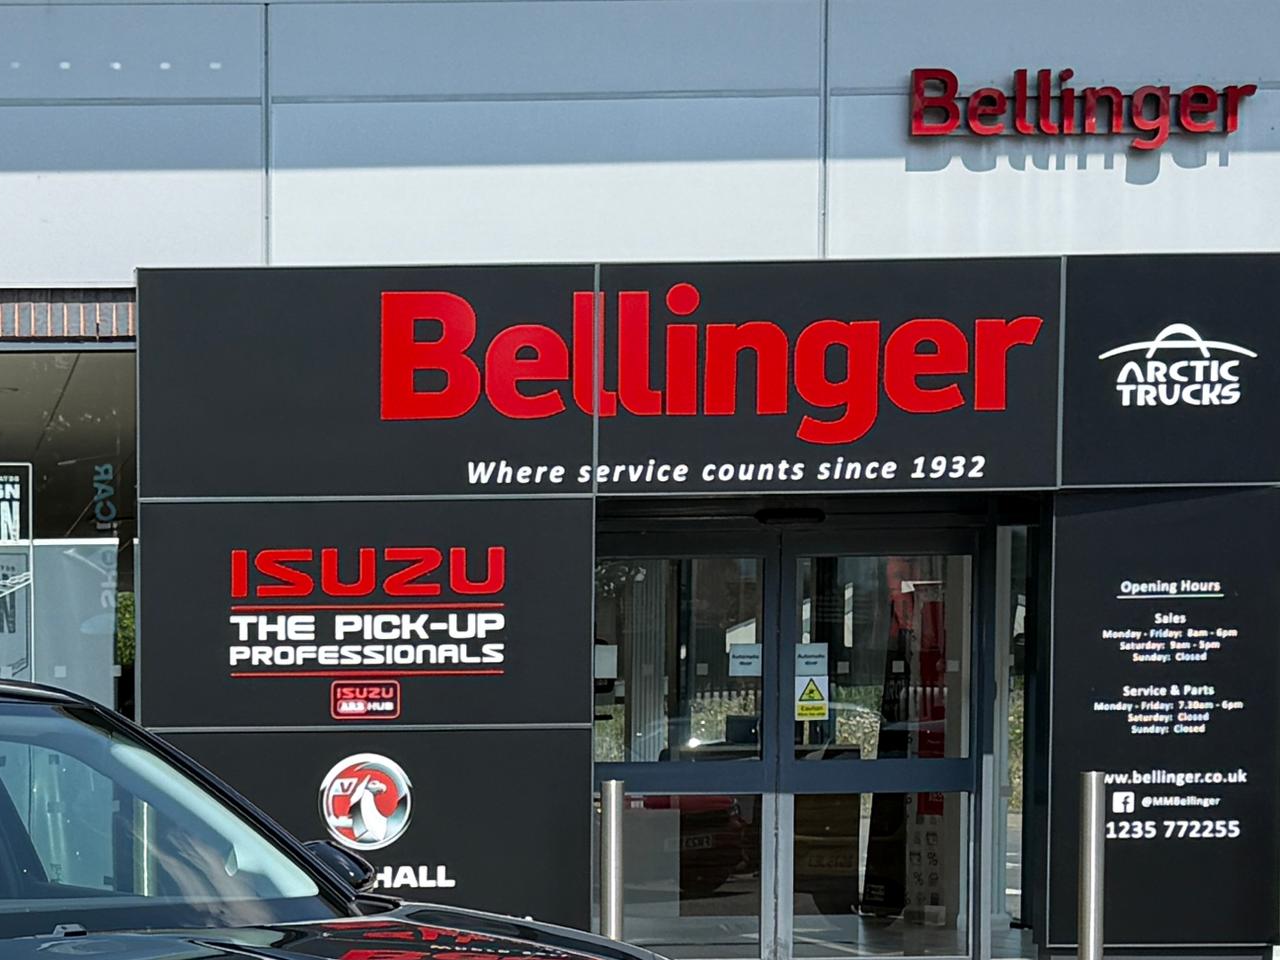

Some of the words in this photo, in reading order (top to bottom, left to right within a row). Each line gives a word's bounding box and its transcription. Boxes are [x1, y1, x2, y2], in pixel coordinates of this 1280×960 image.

[911, 68, 1257, 149] Bellinger
[380, 283, 1043, 445] Bellinger
[1117, 360, 1240, 383] ARCTIC
[1116, 383, 1241, 406] TRUCKS
[468, 460, 565, 484] Where
[577, 459, 689, 483] service
[702, 459, 805, 482] counts
[817, 457, 898, 480] since
[911, 455, 986, 479] 1932
[231, 547, 505, 597] ISUZU
[1120, 580, 1177, 595] Opening
[1180, 580, 1221, 592] Hours
[1154, 612, 1187, 624] Sales
[229, 615, 315, 641] THE
[335, 613, 505, 640] PICK-UP
[1102, 630, 1142, 640] Monday
[229, 643, 505, 666] PROFESSIONALS
[1175, 652, 1208, 661] Closed
[337, 687, 394, 699] ISUZU
[1122, 685, 1167, 697] Service
[1170, 685, 1180, 696] &
[1183, 685, 1216, 696] Parts
[1093, 702, 1133, 712] Monday
[1177, 712, 1210, 721] Closed
[1173, 724, 1206, 733] Closed
[1104, 769, 1248, 786] ww.bellinger.co.uk
[1106, 821, 1157, 839] 1235
[1163, 820, 1241, 839] 772255
